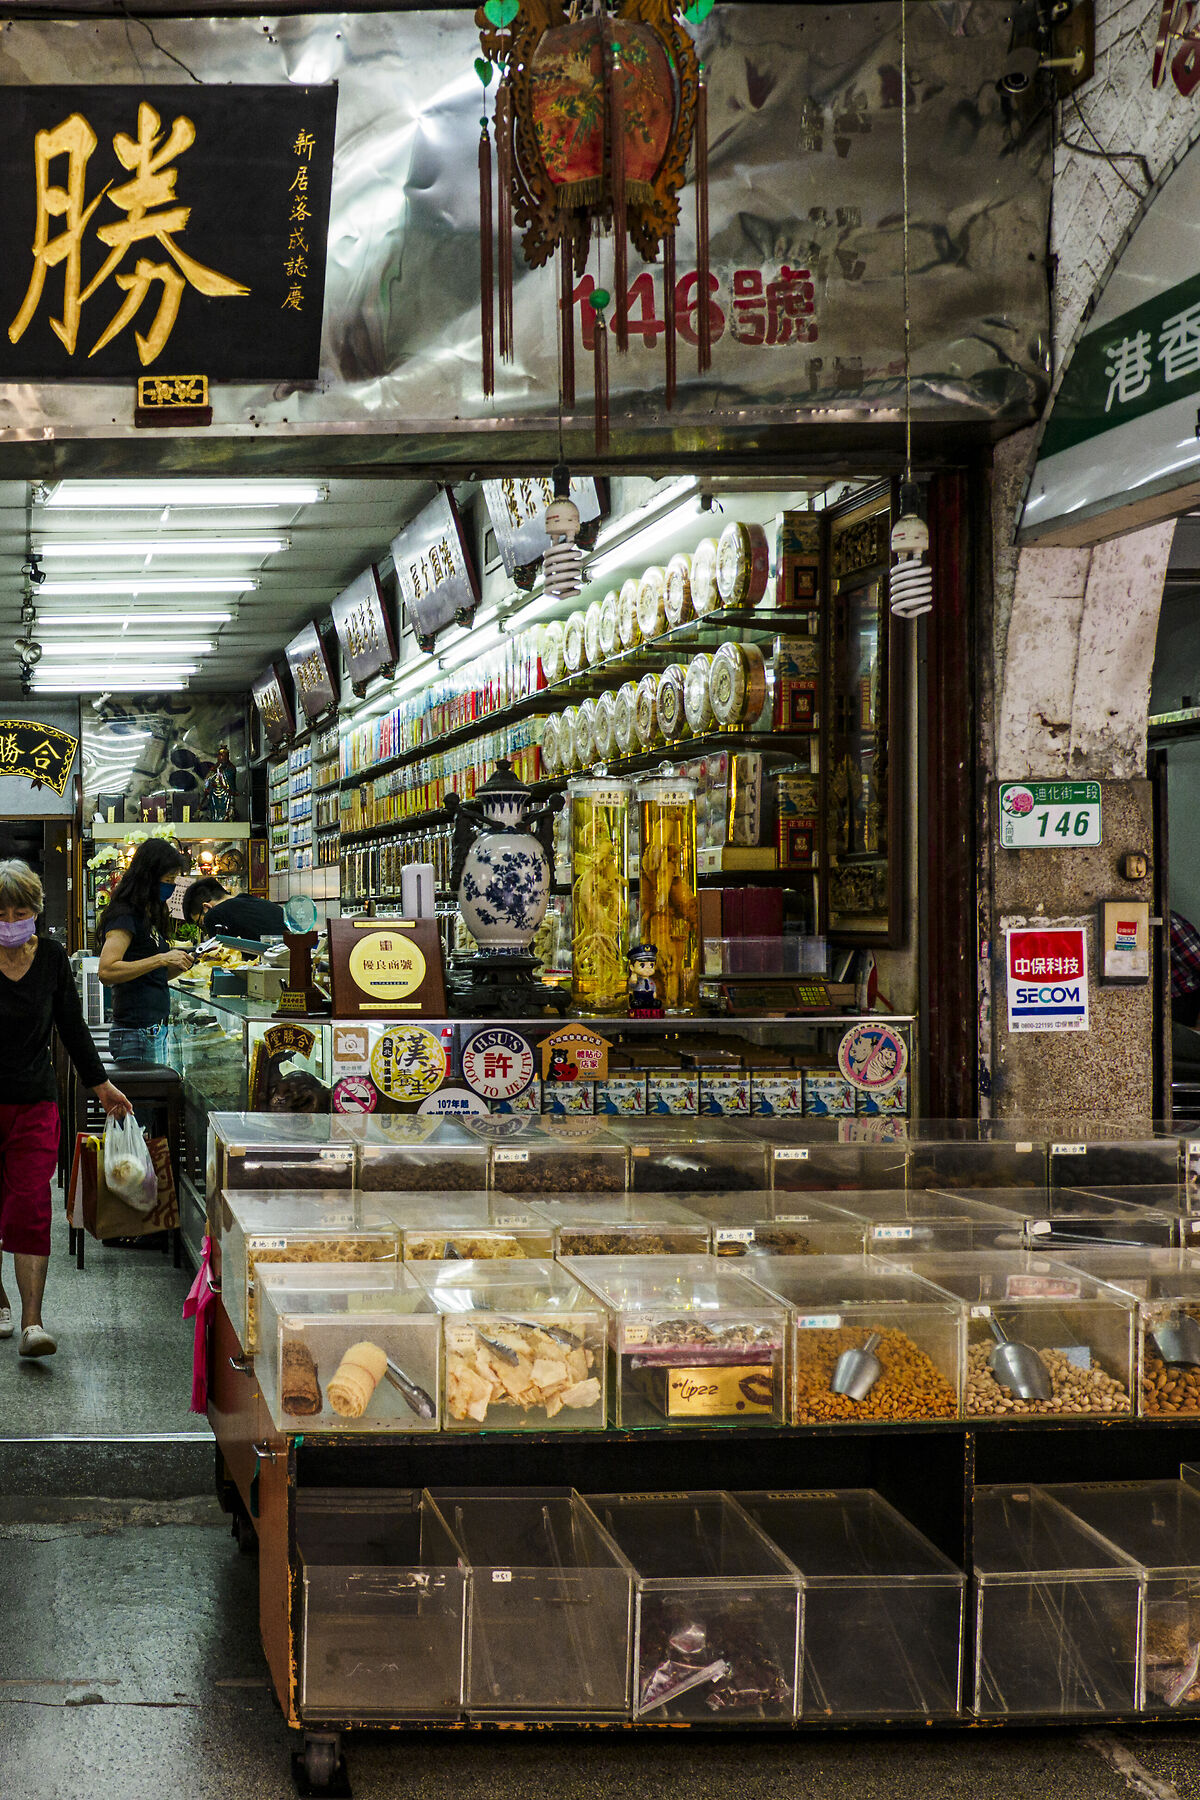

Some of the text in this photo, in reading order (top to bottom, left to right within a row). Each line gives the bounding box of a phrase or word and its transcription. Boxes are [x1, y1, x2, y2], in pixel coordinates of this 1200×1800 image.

[1034, 785, 1098, 800] 迪化街一段
[1036, 811, 1090, 837] 146
[363, 960, 413, 970] 優良商號
[1015, 957, 1079, 975] 中保科技
[1016, 987, 1080, 1004] SECOM
[270, 1029, 310, 1048] 合勝堂
[477, 1032, 521, 1052] HSU'S
[464, 1051, 532, 1098] ROOT TO HEALTH
[483, 1052, 514, 1079] 許
